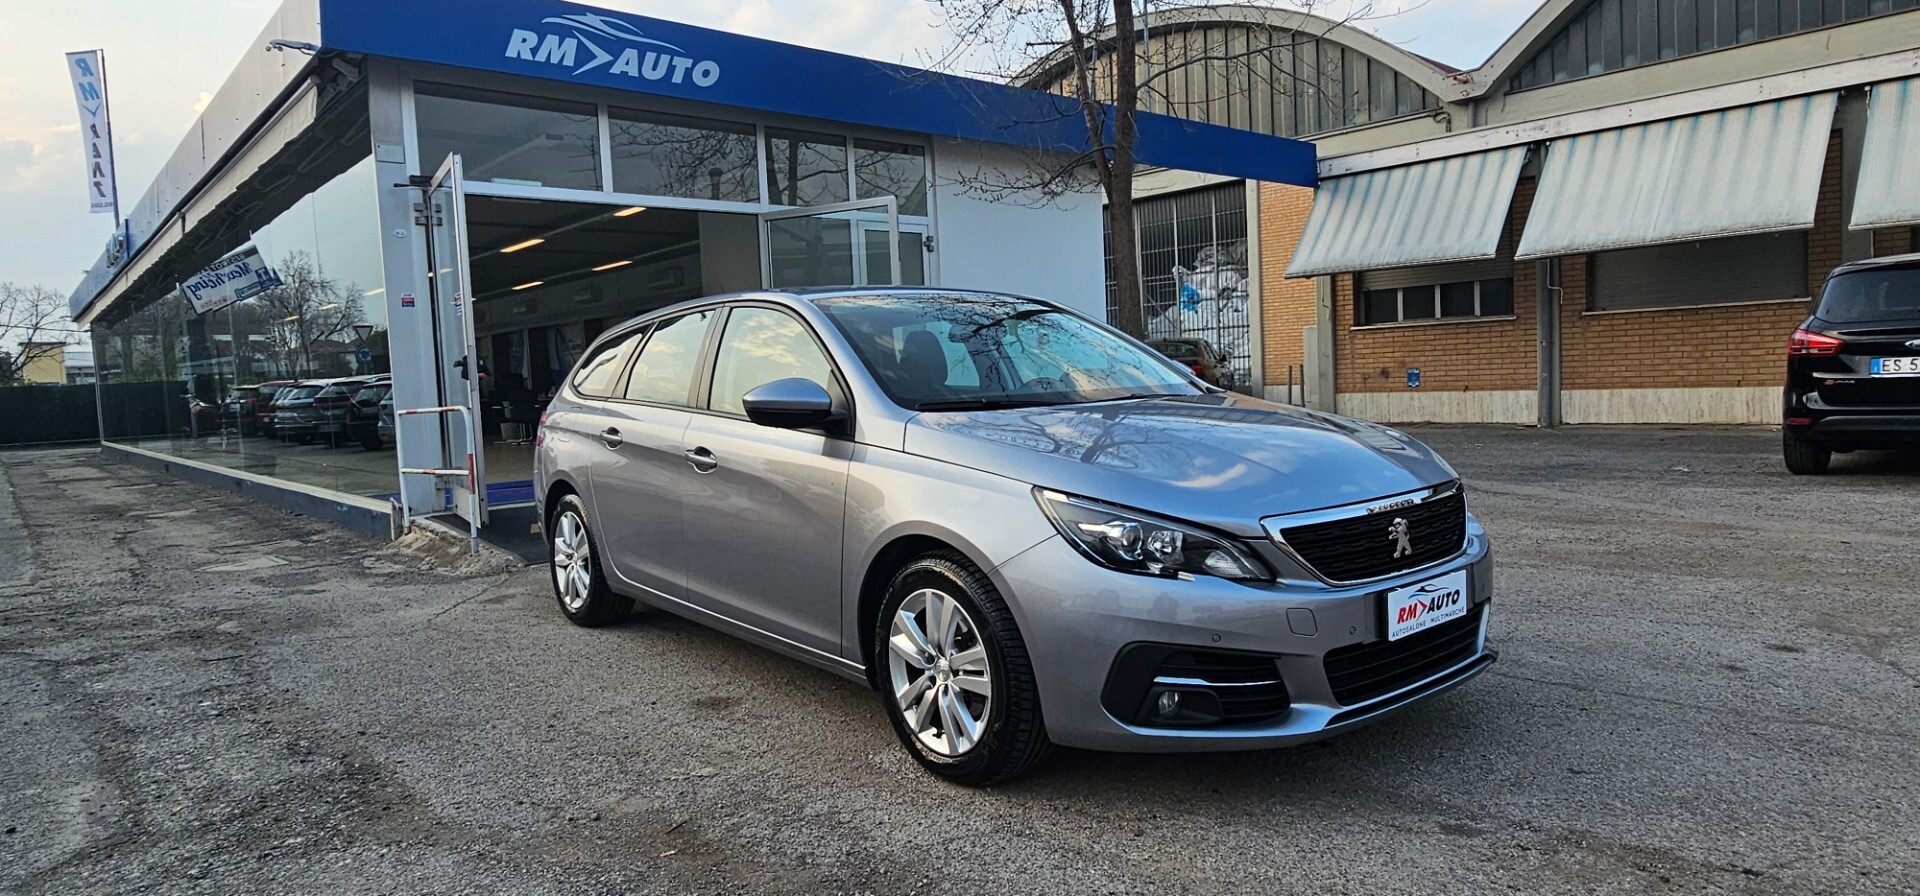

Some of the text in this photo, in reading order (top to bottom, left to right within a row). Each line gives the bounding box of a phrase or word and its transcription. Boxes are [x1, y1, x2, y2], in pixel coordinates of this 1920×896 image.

[505, 28, 720, 87] RM AUTO
[1882, 359, 1901, 371] ES
[1391, 606, 1465, 638] AUTOSALONE MULTIMARCHE
[1397, 589, 1461, 625] RM AUTO
